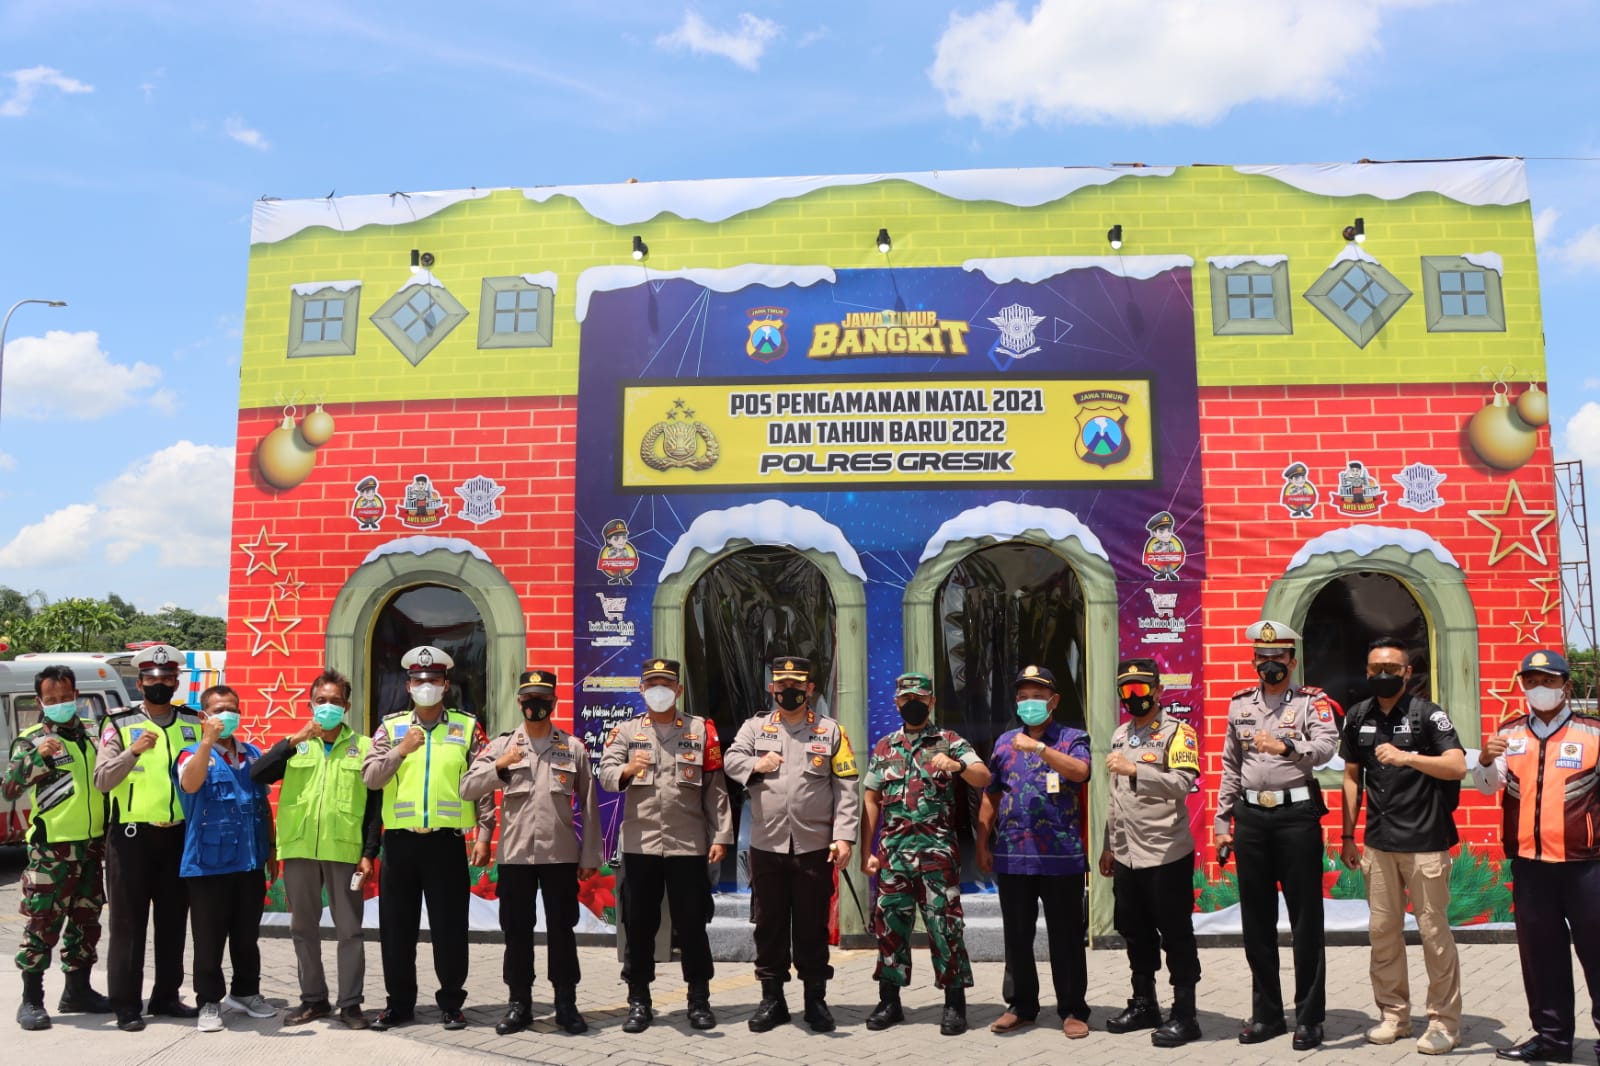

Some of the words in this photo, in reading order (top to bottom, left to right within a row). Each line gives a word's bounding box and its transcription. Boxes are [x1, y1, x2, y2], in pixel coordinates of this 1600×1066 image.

[841, 311, 883, 328] JAWA
[886, 310, 937, 327] TIMUR
[808, 320, 969, 359] BANGKIT
[730, 393, 772, 415] POS
[776, 391, 921, 415] PENGAMANAN
[925, 390, 988, 412] NATAL
[993, 390, 1043, 412] 2021
[1080, 392, 1100, 402] JAWA
[1101, 391, 1124, 401] TIMUR
[769, 422, 812, 444] DAN
[816, 421, 884, 443] TAHUN
[889, 420, 947, 442] BARU
[952, 420, 1005, 442] 2022
[760, 453, 893, 473] POLRES
[897, 452, 1014, 471] GRESIK
[551, 751, 575, 759] POLRI
[678, 741, 702, 750] POLRI
